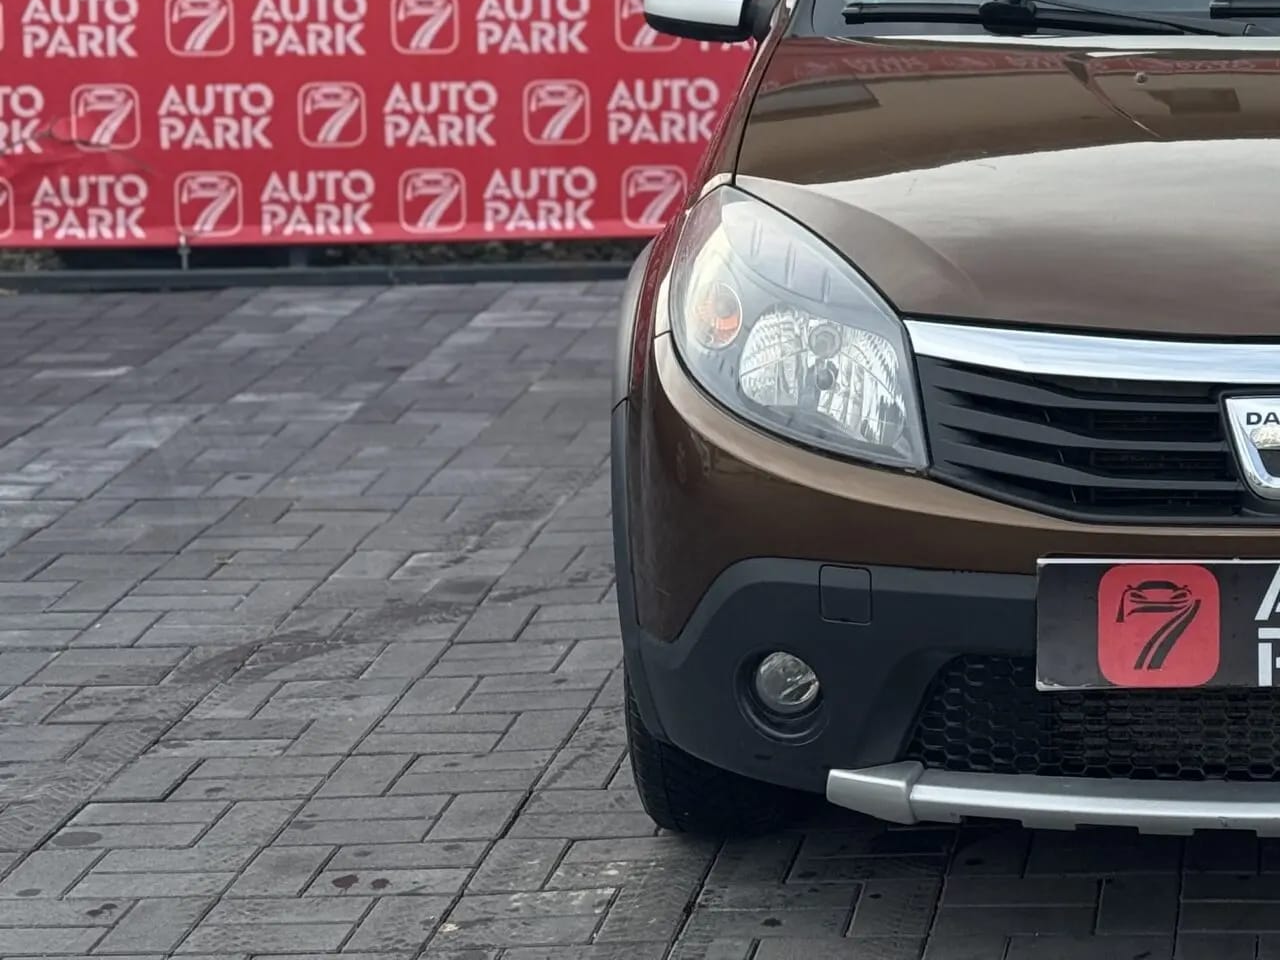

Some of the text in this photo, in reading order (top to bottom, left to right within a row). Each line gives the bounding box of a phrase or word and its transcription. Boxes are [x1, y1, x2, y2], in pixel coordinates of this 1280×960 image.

[23, 25, 136, 57] PARK
[253, 22, 365, 55] PARK
[478, 20, 587, 53] PARK
[158, 83, 273, 115] AUTO
[384, 81, 497, 113] AUTO
[608, 78, 719, 110] AUTO
[160, 115, 272, 149] PARK
[385, 113, 495, 146] PARK
[609, 110, 717, 144] PARK
[33, 174, 147, 206] AUTO
[261, 170, 374, 202] AUTO
[484, 167, 596, 199] AUTO
[33, 207, 146, 239] PARK
[262, 203, 372, 236] PARK
[484, 200, 594, 232] PARK
